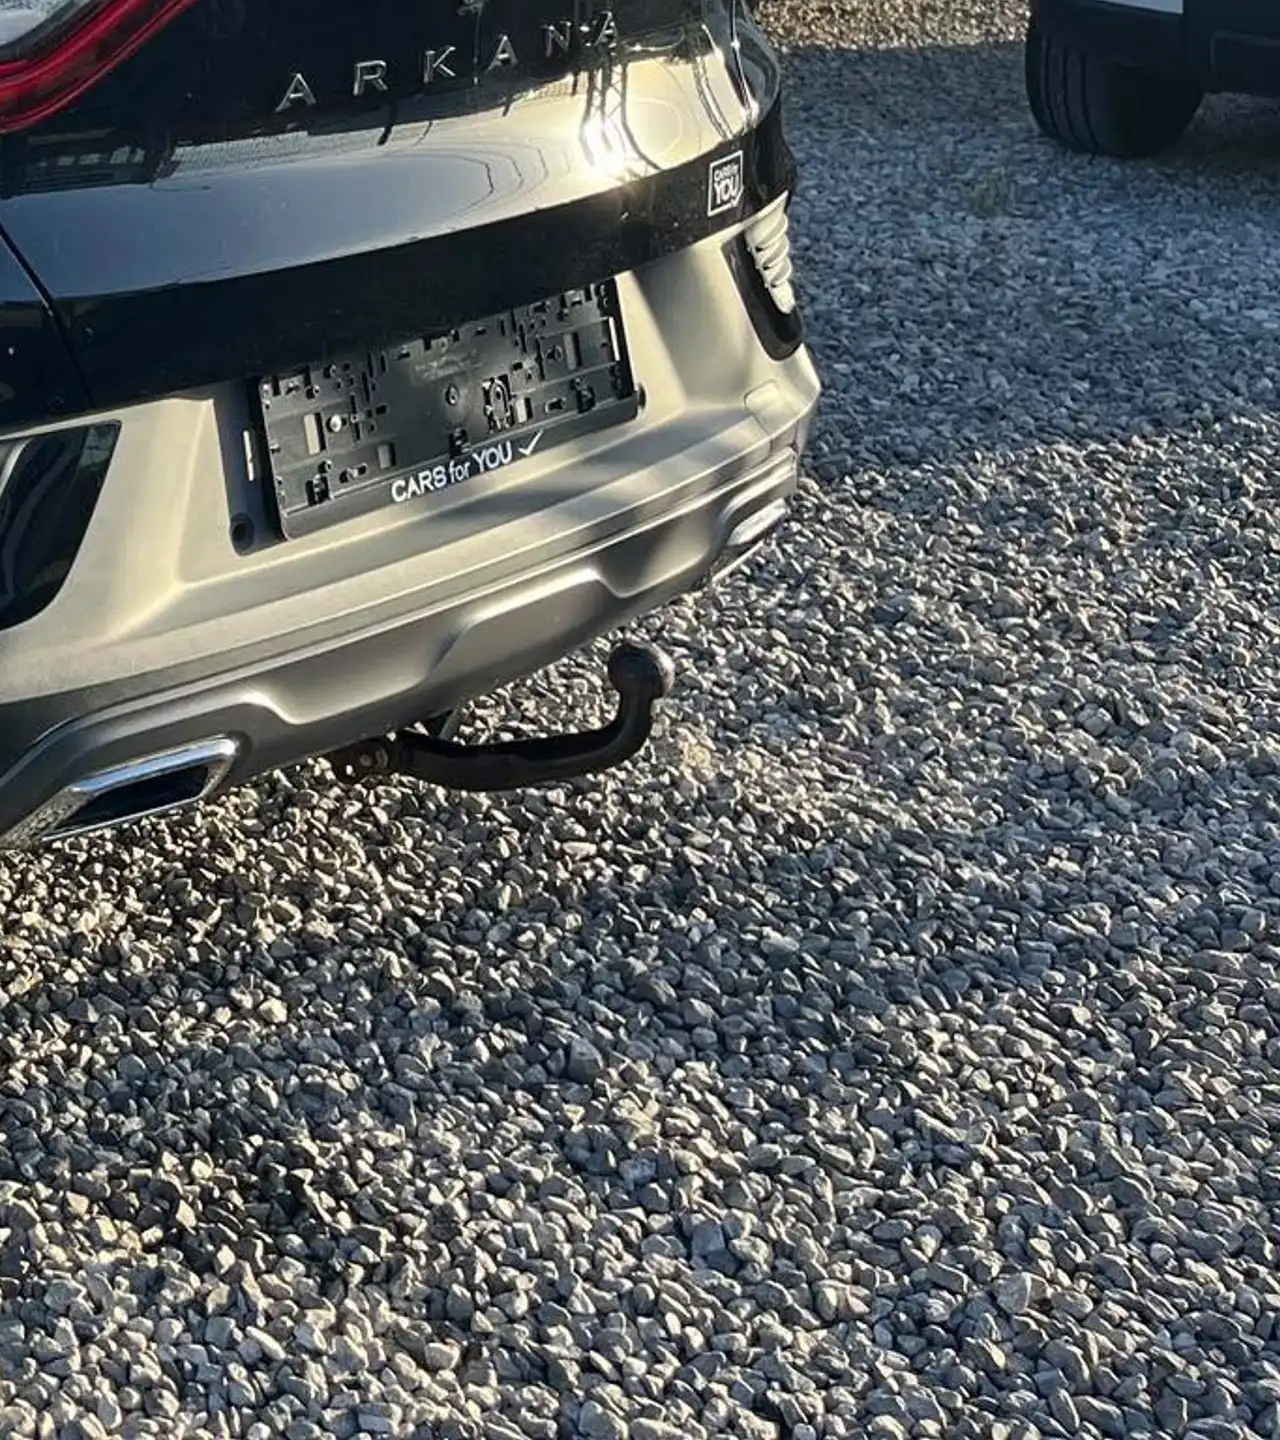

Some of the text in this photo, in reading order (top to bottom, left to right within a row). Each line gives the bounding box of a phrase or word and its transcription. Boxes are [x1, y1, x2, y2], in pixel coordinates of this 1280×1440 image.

[274, 10, 620, 112] ARKANA
[713, 173, 740, 205] YOU
[391, 440, 513, 502] CARS for YOU
